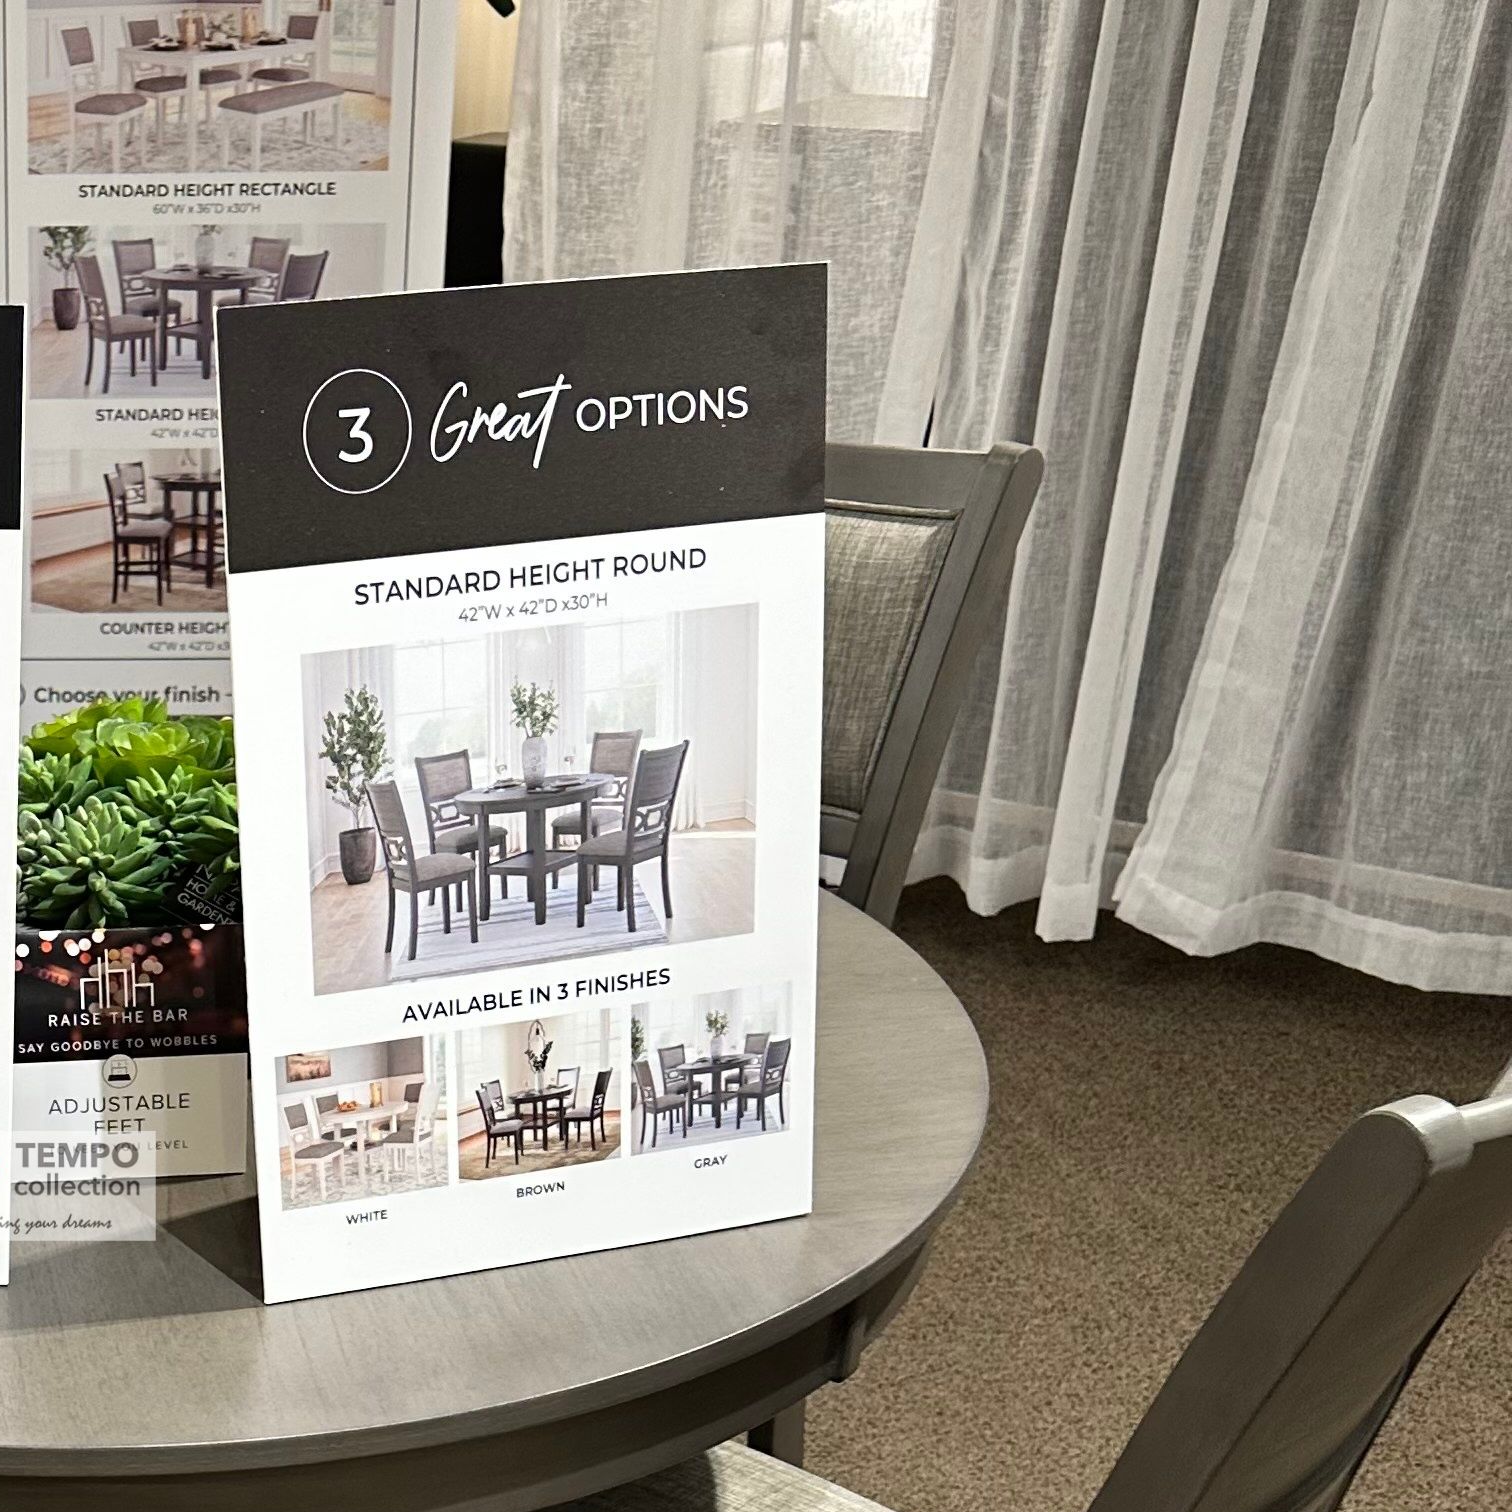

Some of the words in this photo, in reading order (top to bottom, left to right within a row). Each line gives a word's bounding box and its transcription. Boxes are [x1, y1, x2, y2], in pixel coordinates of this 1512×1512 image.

[79, 184, 169, 199] STANDARD
[174, 183, 235, 197] HEIGHT
[239, 181, 337, 196] RECTANGLE
[95, 408, 184, 421] STANDARD
[336, 406, 375, 464] 3
[429, 373, 572, 470] Great
[575, 384, 749, 433] OPTIONS
[354, 569, 501, 606] STANDARD
[509, 558, 605, 589] HEIGHT
[613, 547, 707, 577] ROUND
[458, 605, 502, 623] 42"W
[506, 607, 515, 617] x
[519, 598, 558, 616] 42"D
[100, 622, 174, 635] COUNTER
[164, 686, 219, 703] finish
[186, 878, 226, 905] HOE
[402, 990, 523, 1023] AVAILABLE
[530, 985, 551, 1005] IN
[557, 983, 569, 1000] 3
[576, 968, 670, 997] FINISHES
[48, 1012, 102, 1027] RAISE
[111, 1010, 144, 1024] THE
[153, 1008, 188, 1022] BAR
[18, 1043, 44, 1054] SAY
[51, 1039, 119, 1052] GOODBYE
[126, 1038, 144, 1048] TO
[150, 1034, 218, 1047] WOBBLES
[48, 1093, 190, 1116] ADJUSTABLE
[94, 1118, 145, 1135] FEET
[148, 1140, 188, 1150] LEVEL
[694, 1154, 728, 1170] GRAY
[516, 1181, 565, 1199] BROWN
[346, 1209, 388, 1226] WHITE
